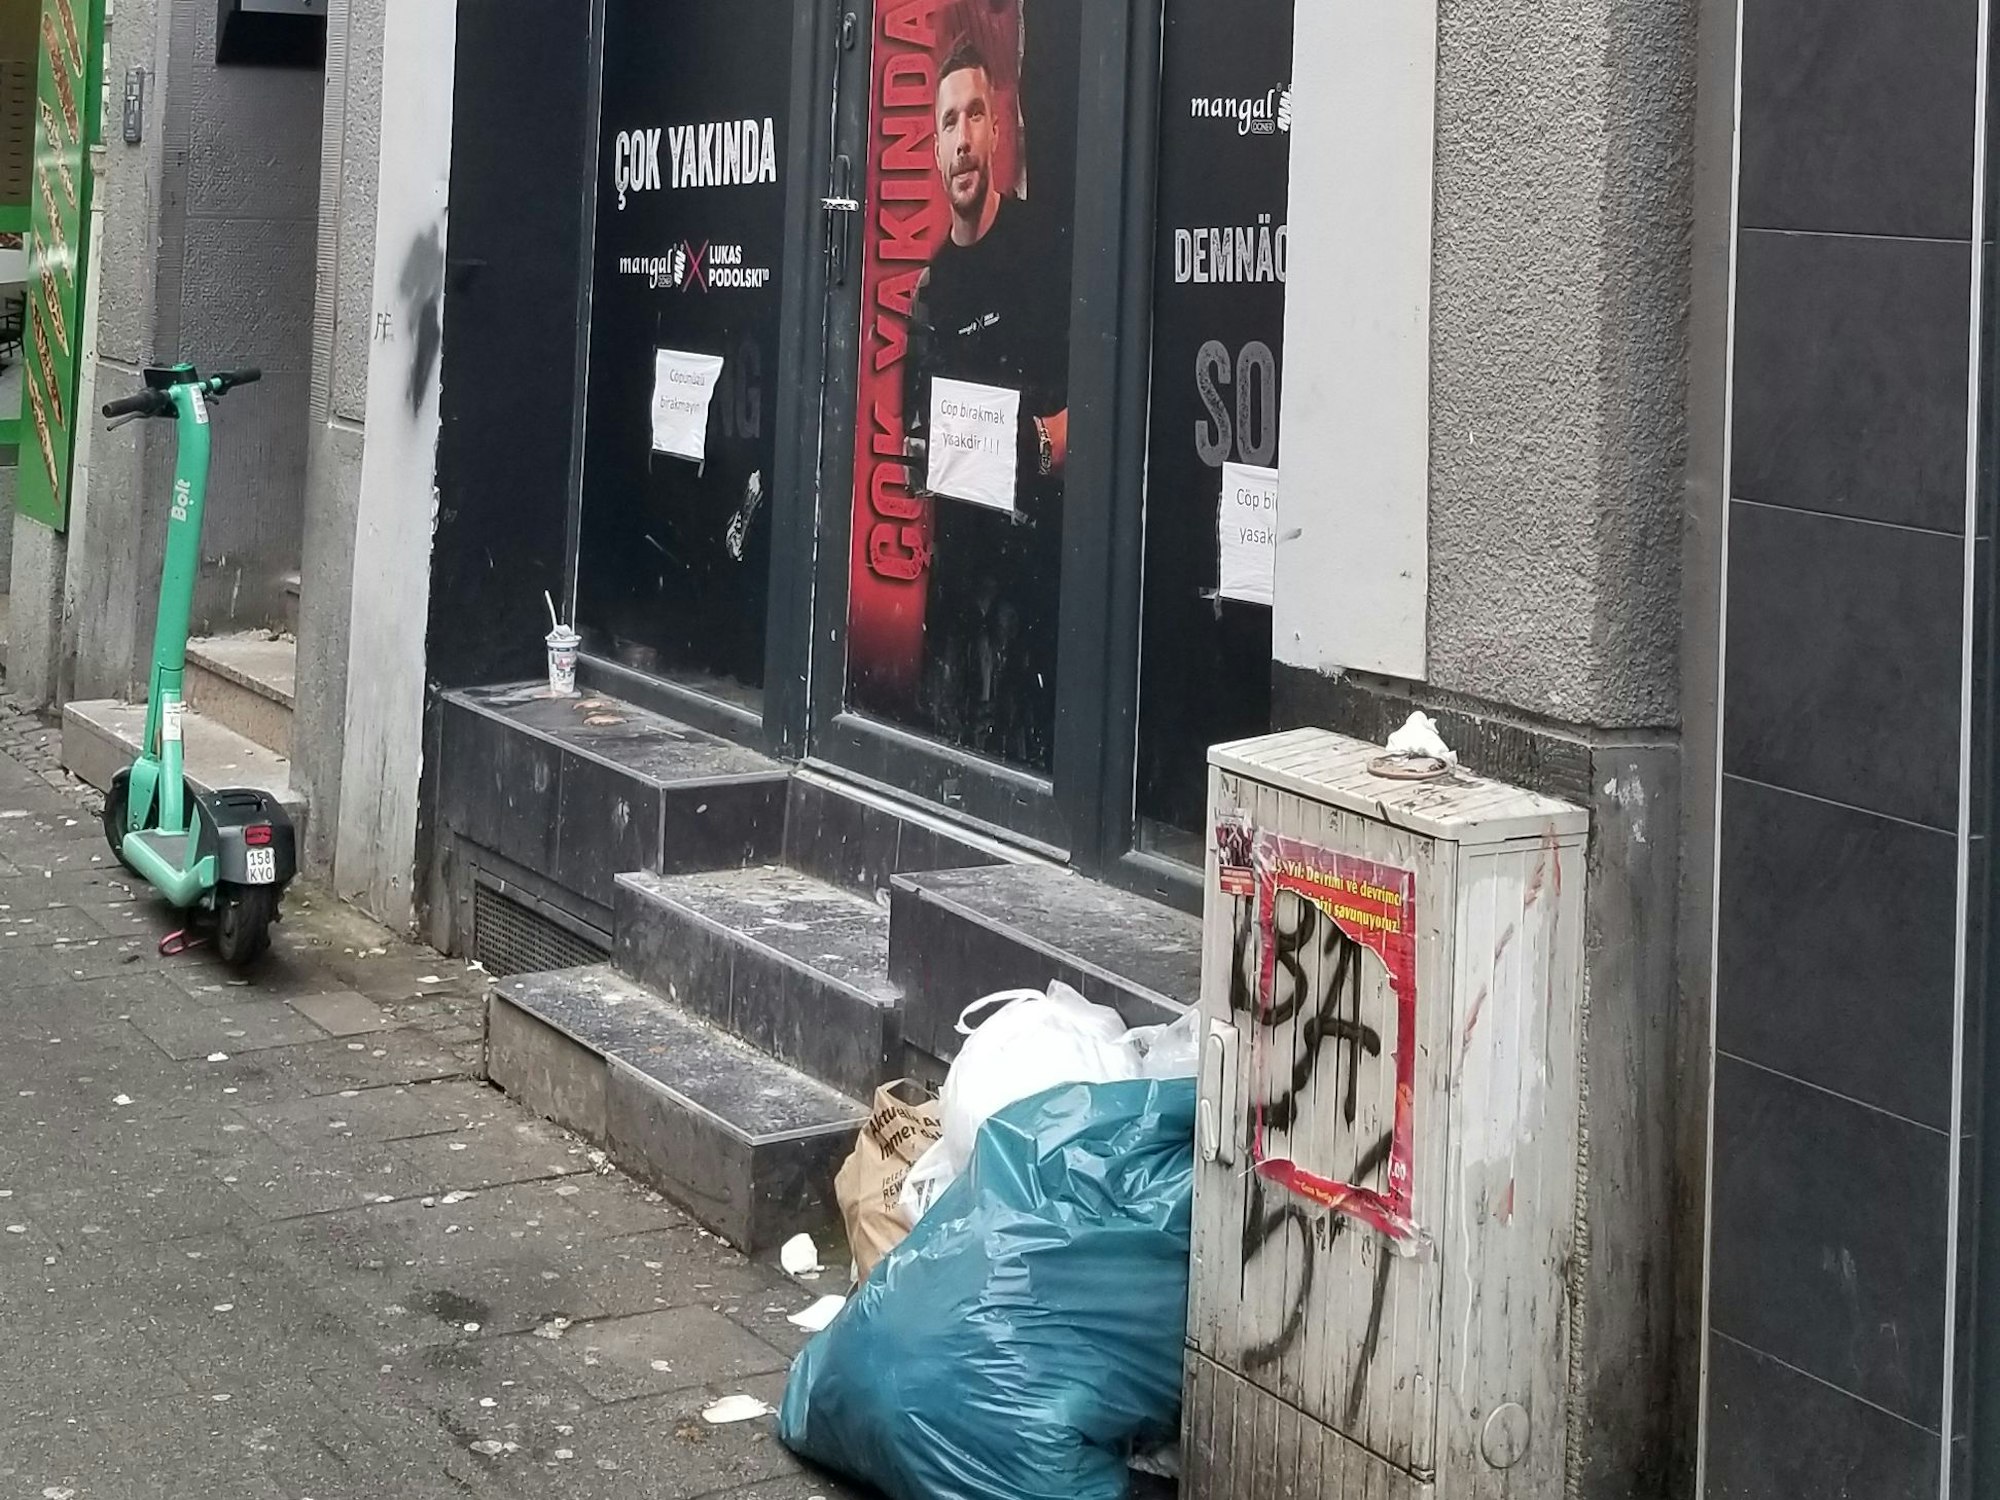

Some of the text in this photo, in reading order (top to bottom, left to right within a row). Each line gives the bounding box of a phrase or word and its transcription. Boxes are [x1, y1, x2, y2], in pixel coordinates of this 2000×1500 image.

[1191, 88, 1276, 135] mangal
[614, 117, 777, 211] ÇOK YAKINDA
[709, 245, 742, 265] LUKAS
[619, 249, 673, 289] mangal
[171, 479, 193, 522] Bolt
[1236, 488, 1278, 512] Cöp bi
[1239, 527, 1277, 546] yasak
[249, 850, 271, 867] 158
[1346, 879, 1358, 895] ve
